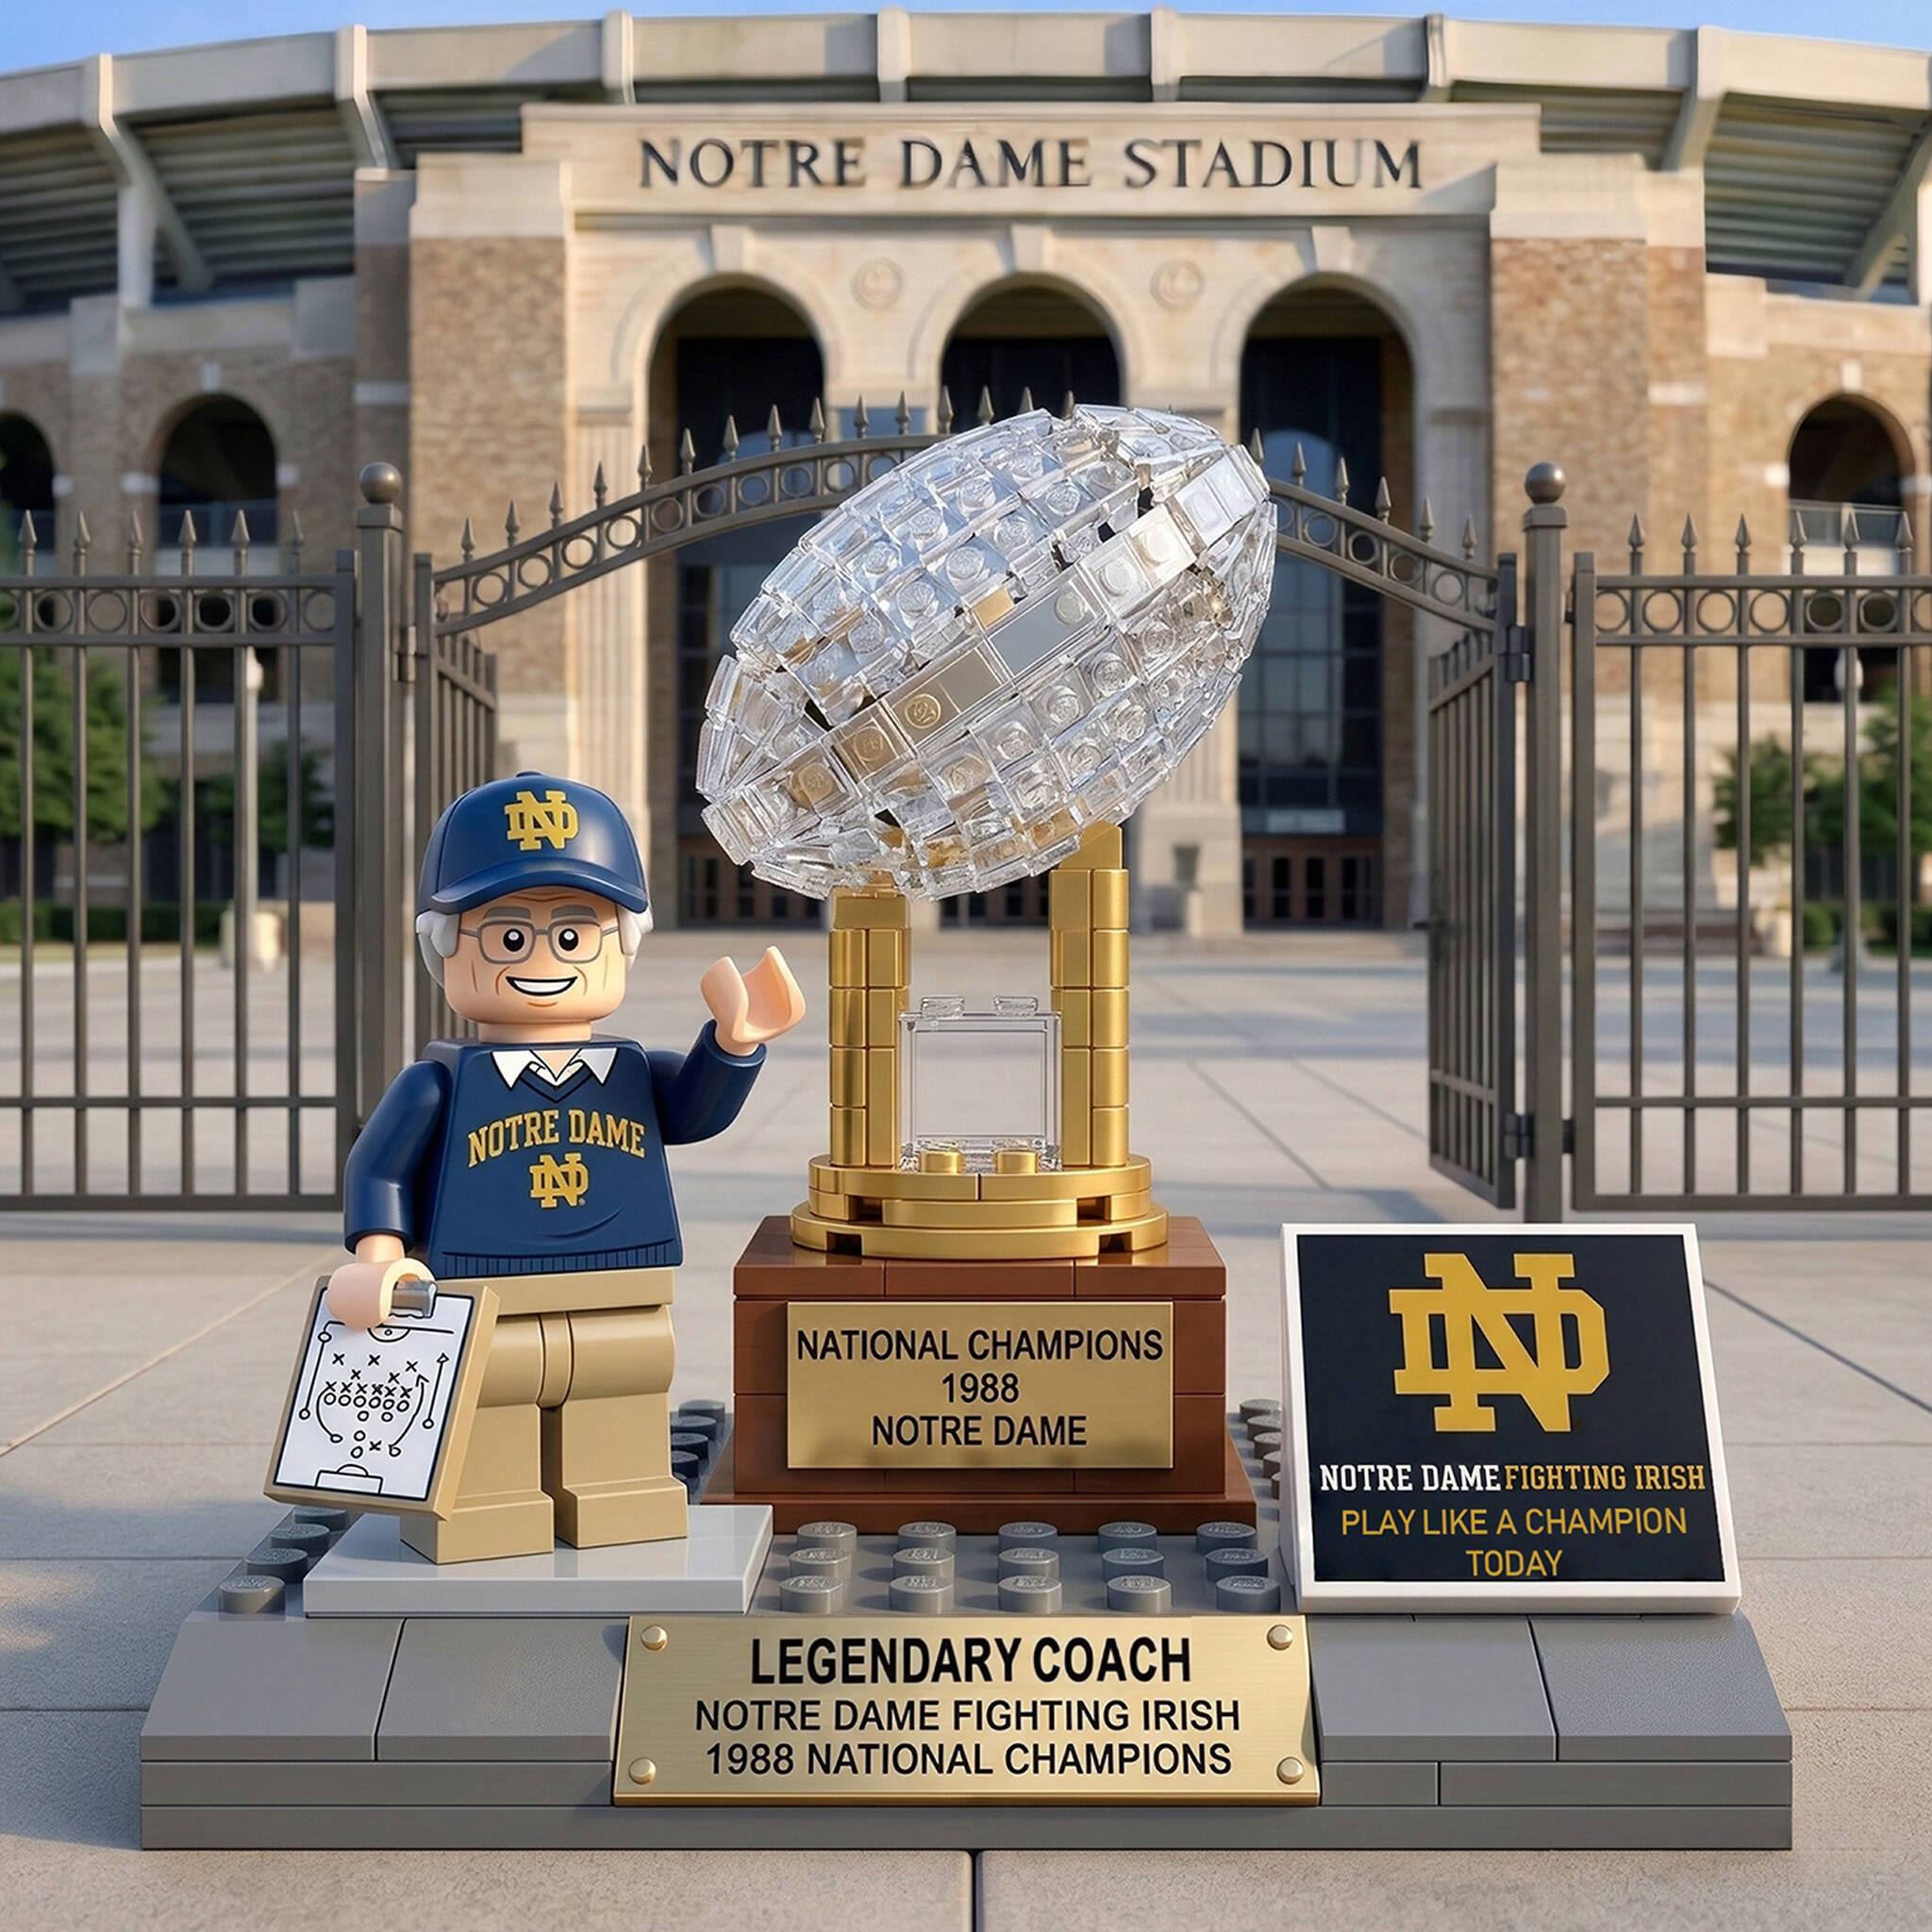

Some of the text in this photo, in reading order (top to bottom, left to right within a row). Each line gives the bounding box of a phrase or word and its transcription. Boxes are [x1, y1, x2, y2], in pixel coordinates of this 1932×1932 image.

[640, 138, 1424, 189] NOTRE DAME STADIUM
[468, 1109, 645, 1167] NOTRE DAME
[797, 1329, 1163, 1360] NATIONAL CHAMPIONS
[941, 1373, 1020, 1404] 1988
[873, 1415, 1087, 1445] NOTRE DAME
[1320, 1464, 1706, 1491] NOTRE DAME FIGHTING IRISH
[1342, 1507, 1687, 1536] PLAY LIKE A CHAMPION
[1466, 1550, 1563, 1576] TODAY
[752, 1637, 1191, 1685] LEGENDARY COACH
[696, 1699, 1241, 1731] NOTRE DAME FIGHTING IRISH
[706, 1742, 1232, 1775] 1988 NATIONAL CHAMPIONS
